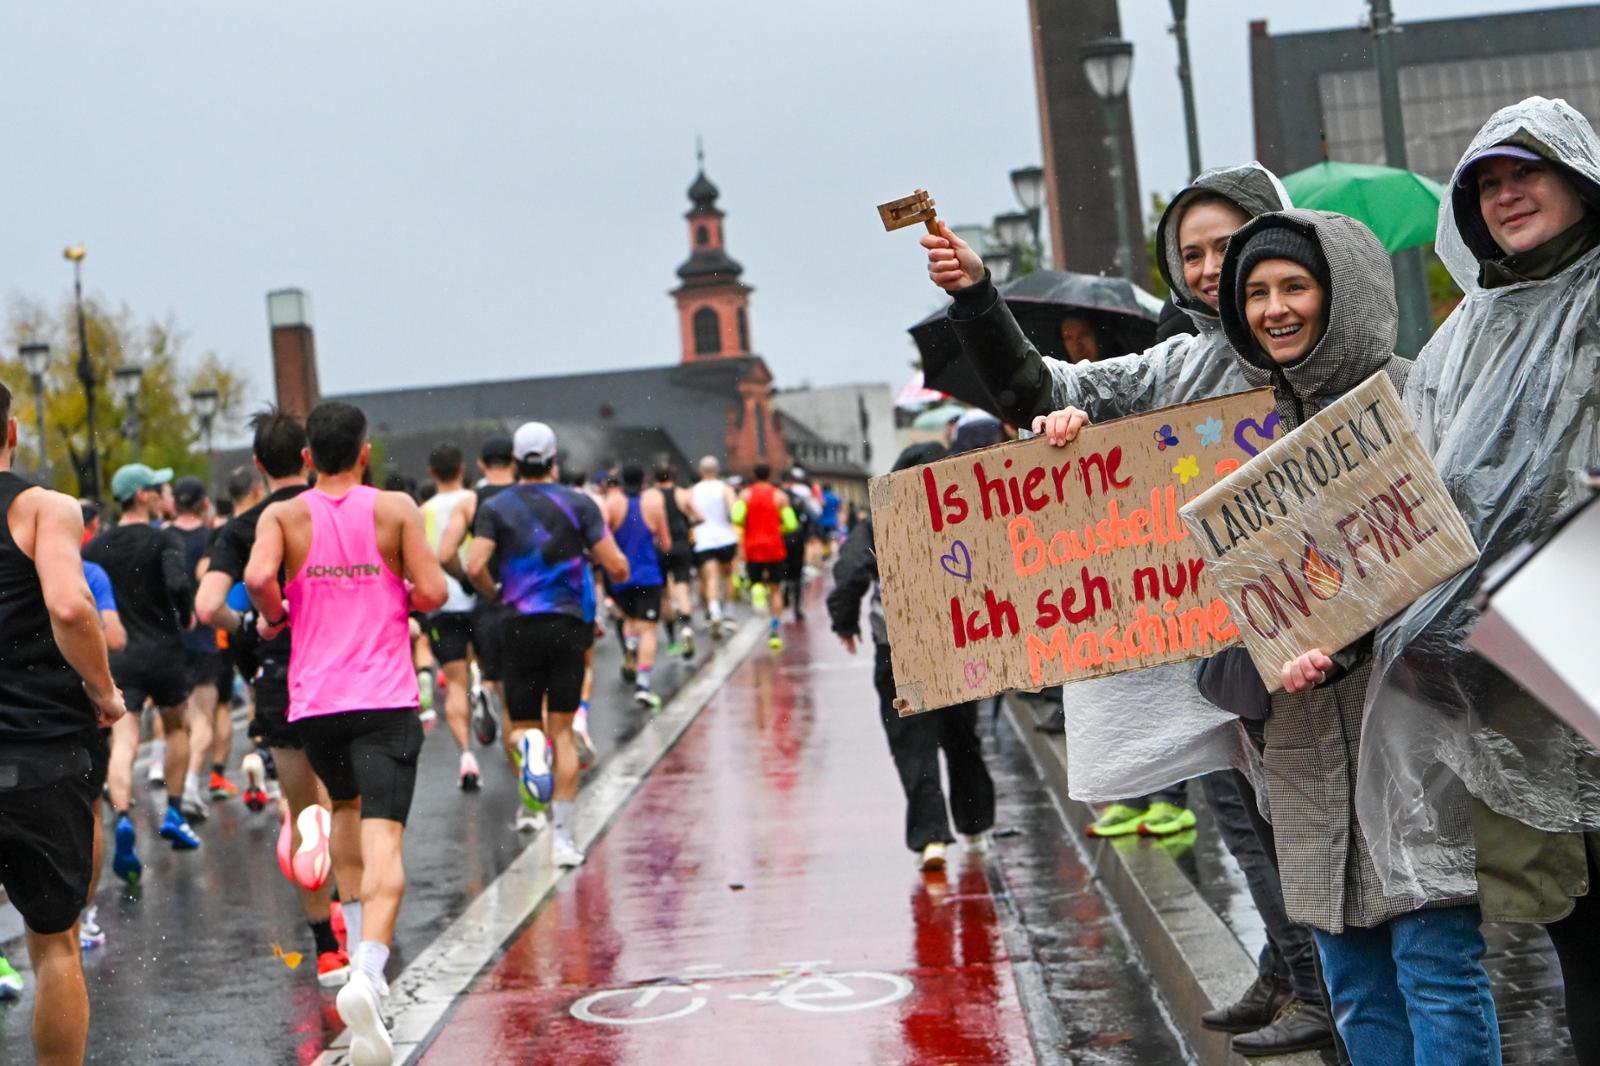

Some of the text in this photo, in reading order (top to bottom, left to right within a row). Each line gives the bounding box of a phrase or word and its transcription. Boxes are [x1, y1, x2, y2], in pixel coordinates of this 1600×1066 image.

[923, 446, 1134, 532] Is hier ne
[1007, 458, 1240, 577] Baustell
[1200, 399, 1394, 557] LAUFPROJEKT
[306, 563, 381, 578] SCHOUTEN
[1241, 473, 1438, 640] ON FIRE
[950, 557, 1206, 648] Ich seh nur
[1026, 598, 1240, 683] Maschine
